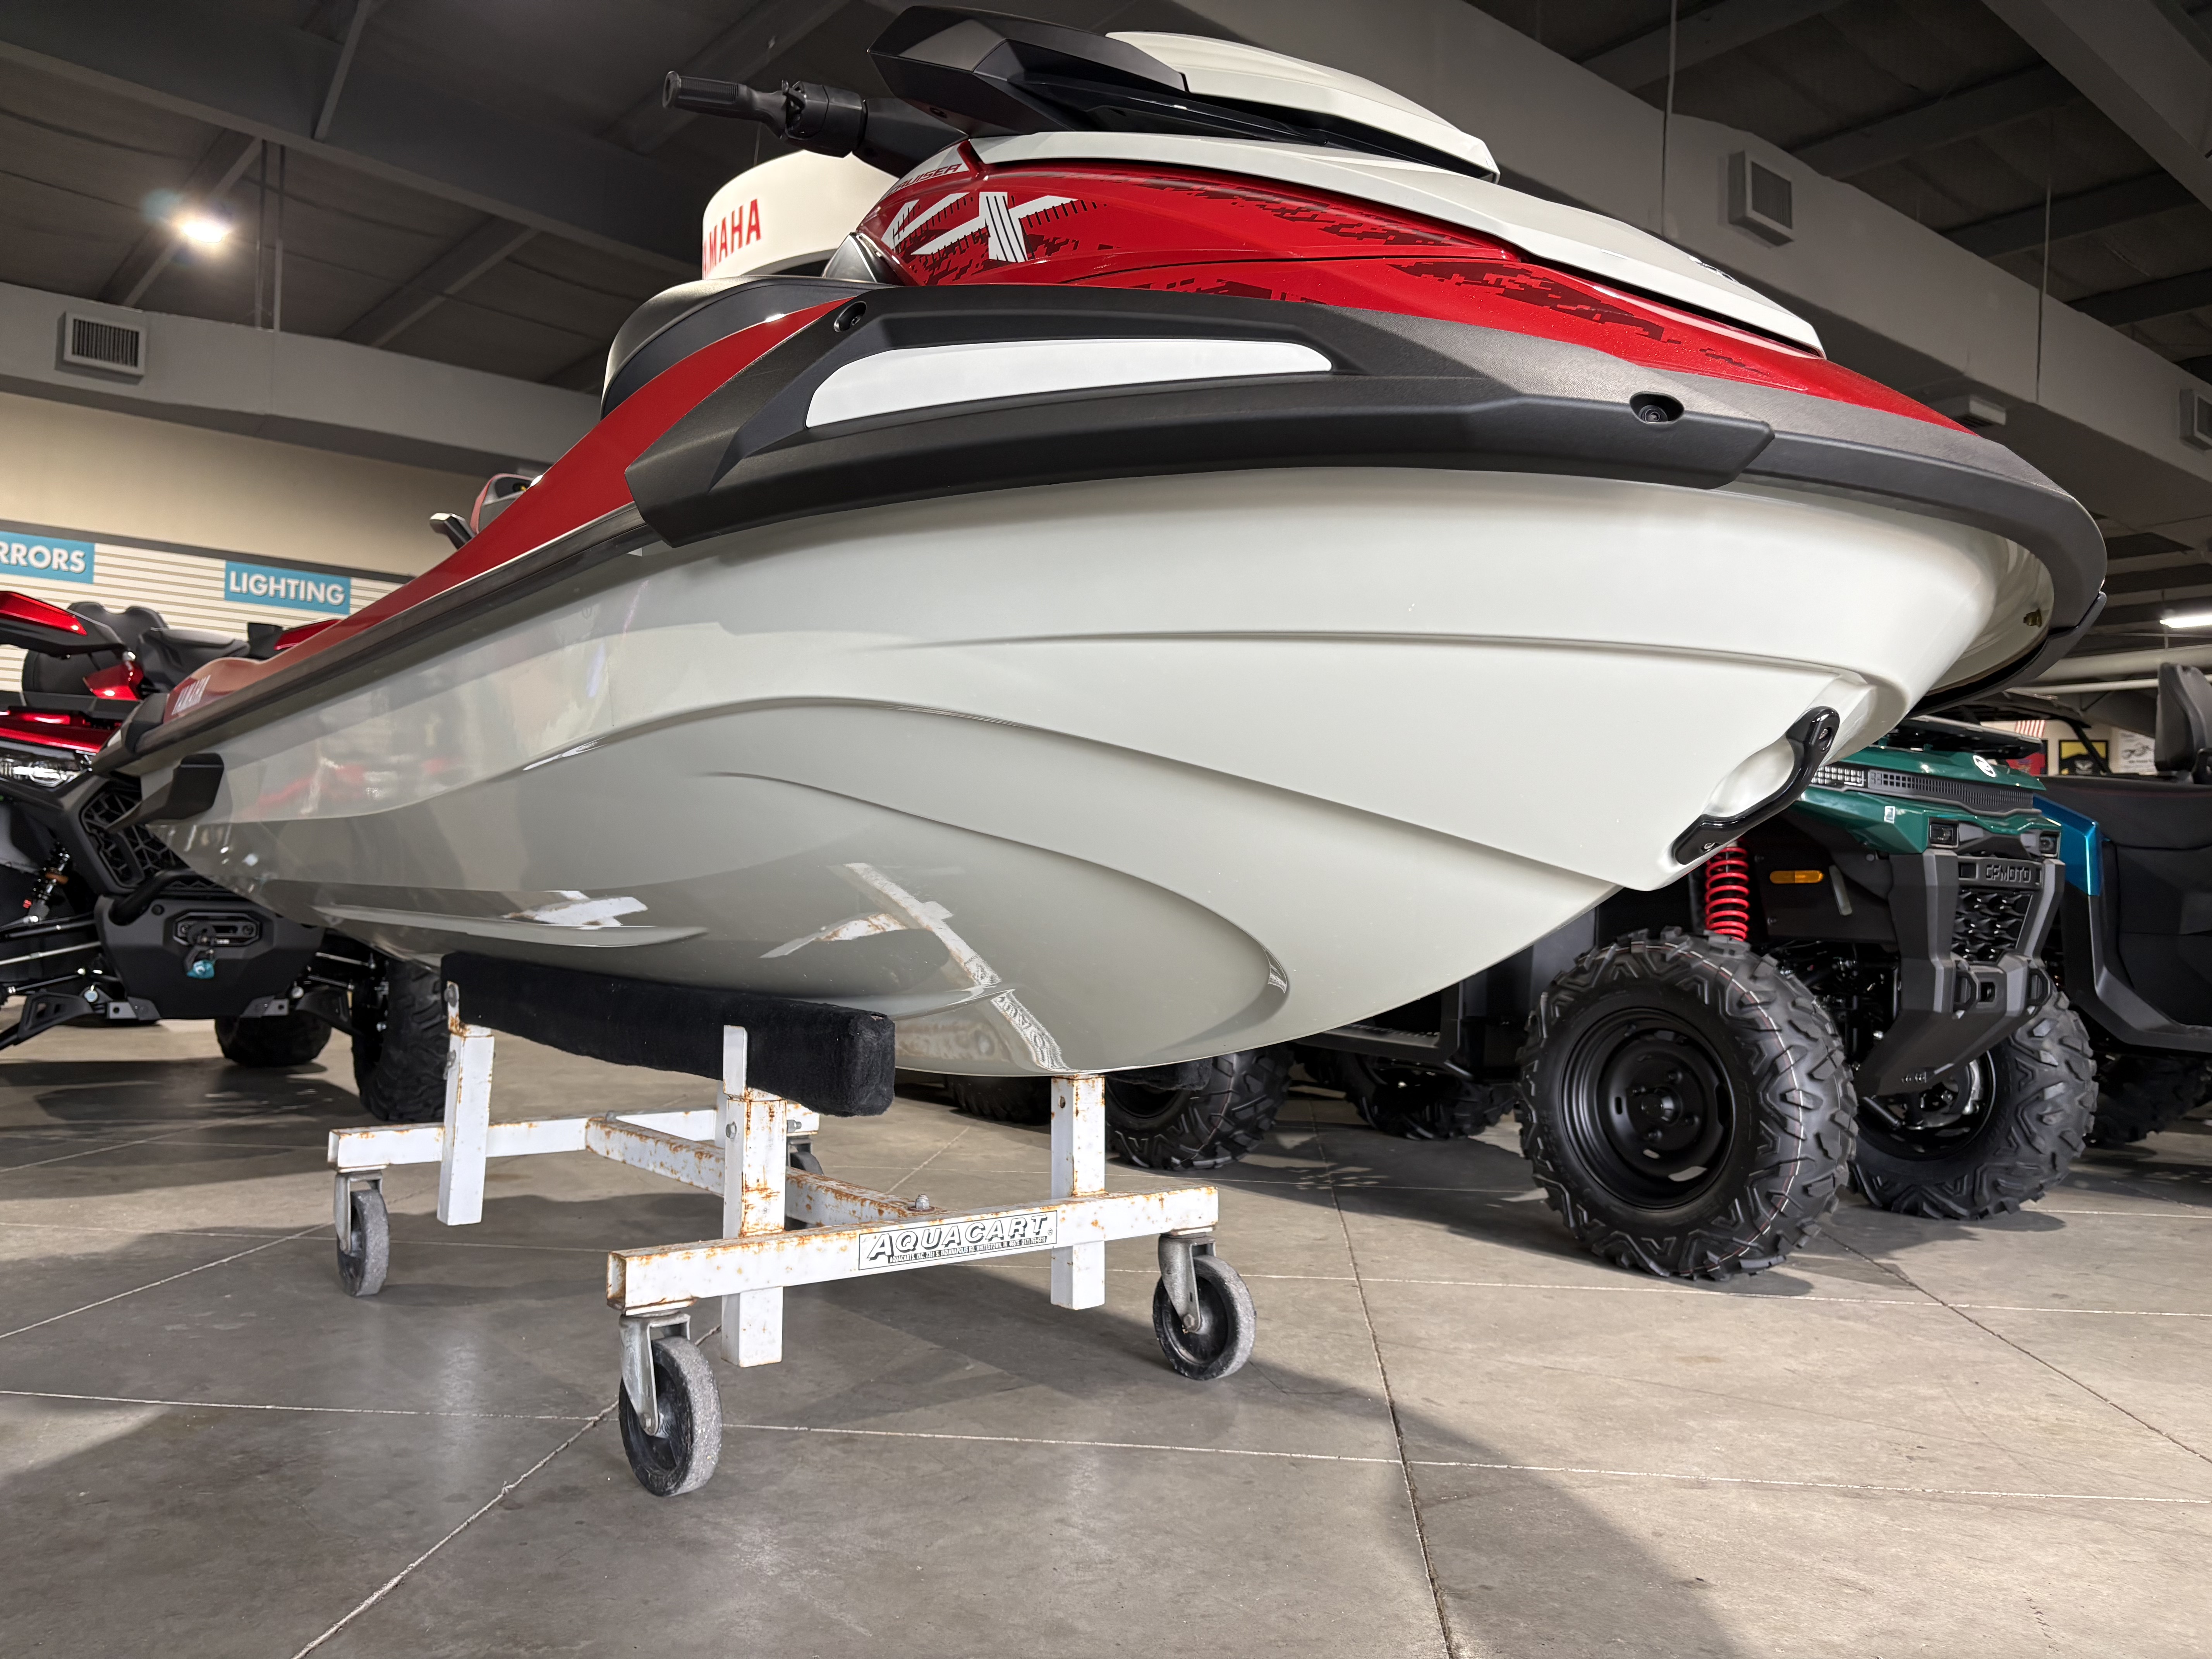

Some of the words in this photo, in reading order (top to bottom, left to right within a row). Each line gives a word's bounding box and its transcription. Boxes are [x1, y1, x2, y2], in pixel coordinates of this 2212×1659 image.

[230, 571, 345, 606] LIGHTING
[1986, 864, 2031, 883] CFMOTO
[867, 1214, 1048, 1261] AQUACART
